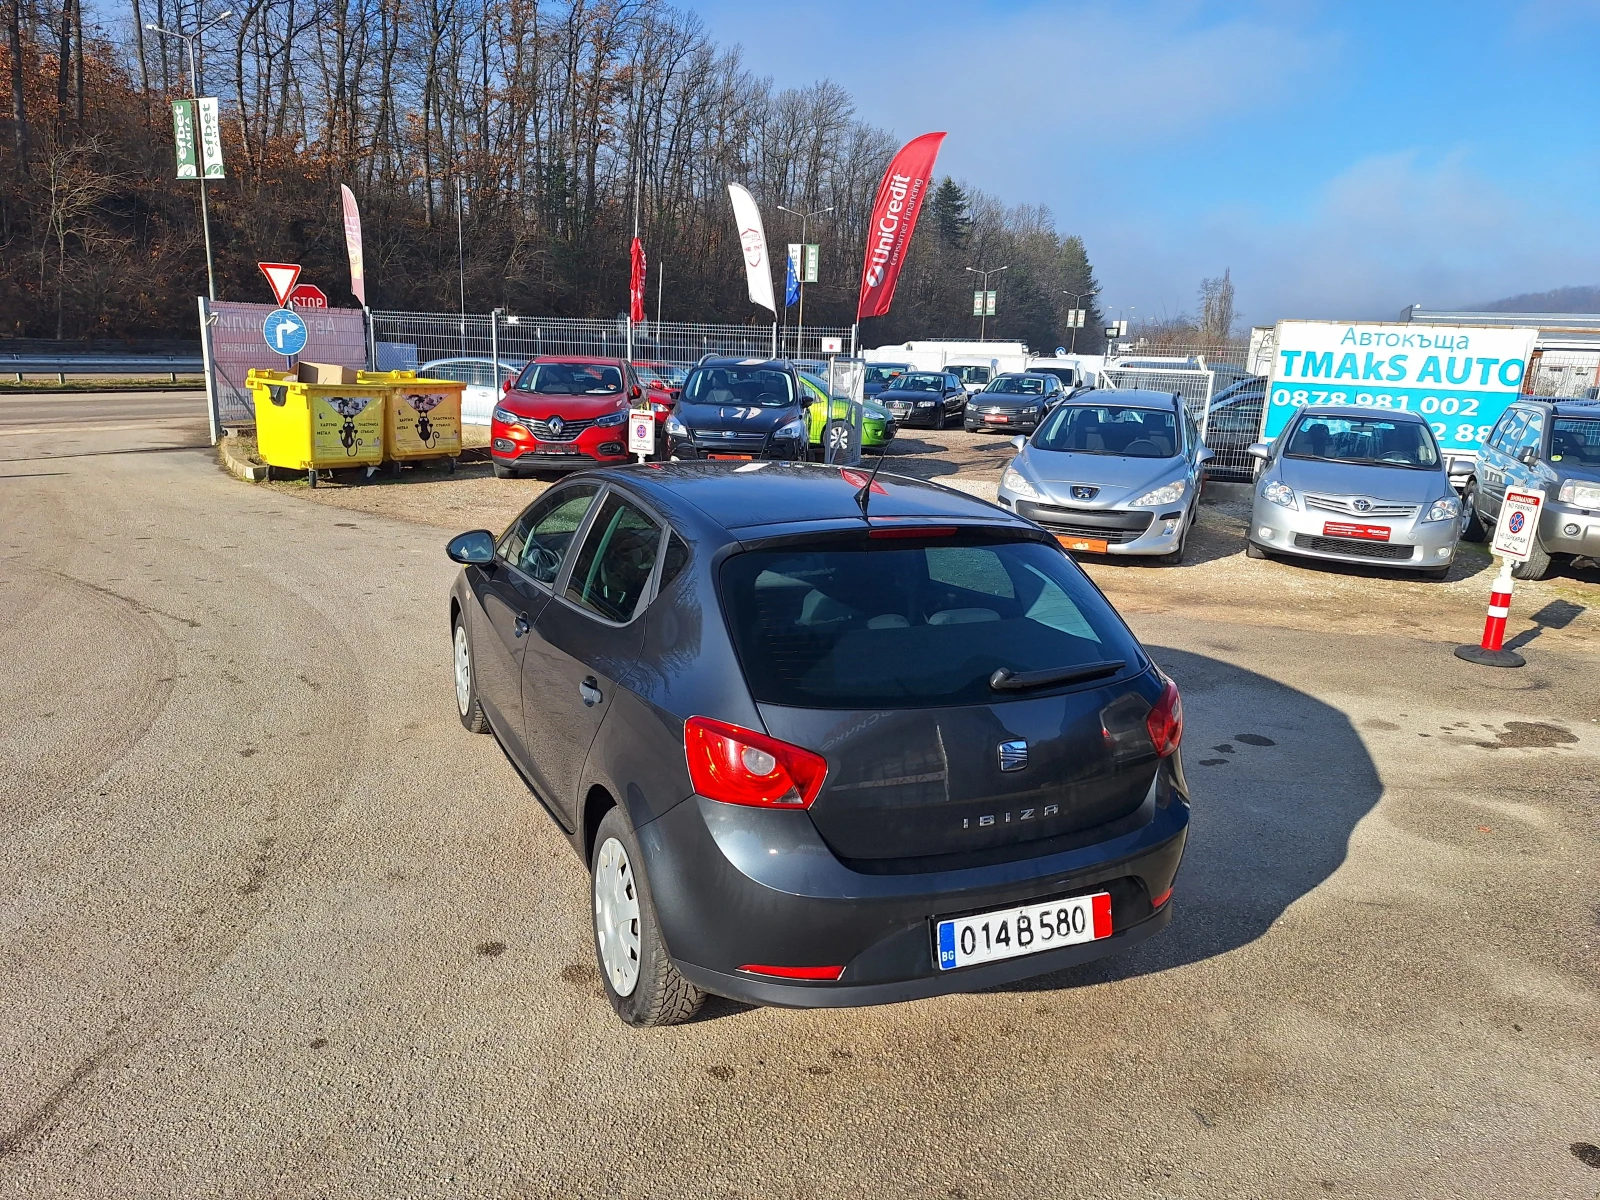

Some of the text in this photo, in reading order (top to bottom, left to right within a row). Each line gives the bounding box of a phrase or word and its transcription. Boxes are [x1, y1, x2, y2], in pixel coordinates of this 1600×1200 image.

[175, 105, 187, 161] efbet
[202, 103, 214, 158] efbet
[872, 173, 911, 264] UniCredit
[890, 178, 924, 266] Consumer Financing
[807, 247, 816, 280] EFBET
[292, 296, 323, 308] STOP
[1340, 327, 1469, 352] Автокъща
[1280, 350, 1524, 387] TMAkS AUTO
[1272, 389, 1480, 417] 0878 981 002
[963, 804, 1059, 829] IBIZA
[941, 950, 955, 962] BG
